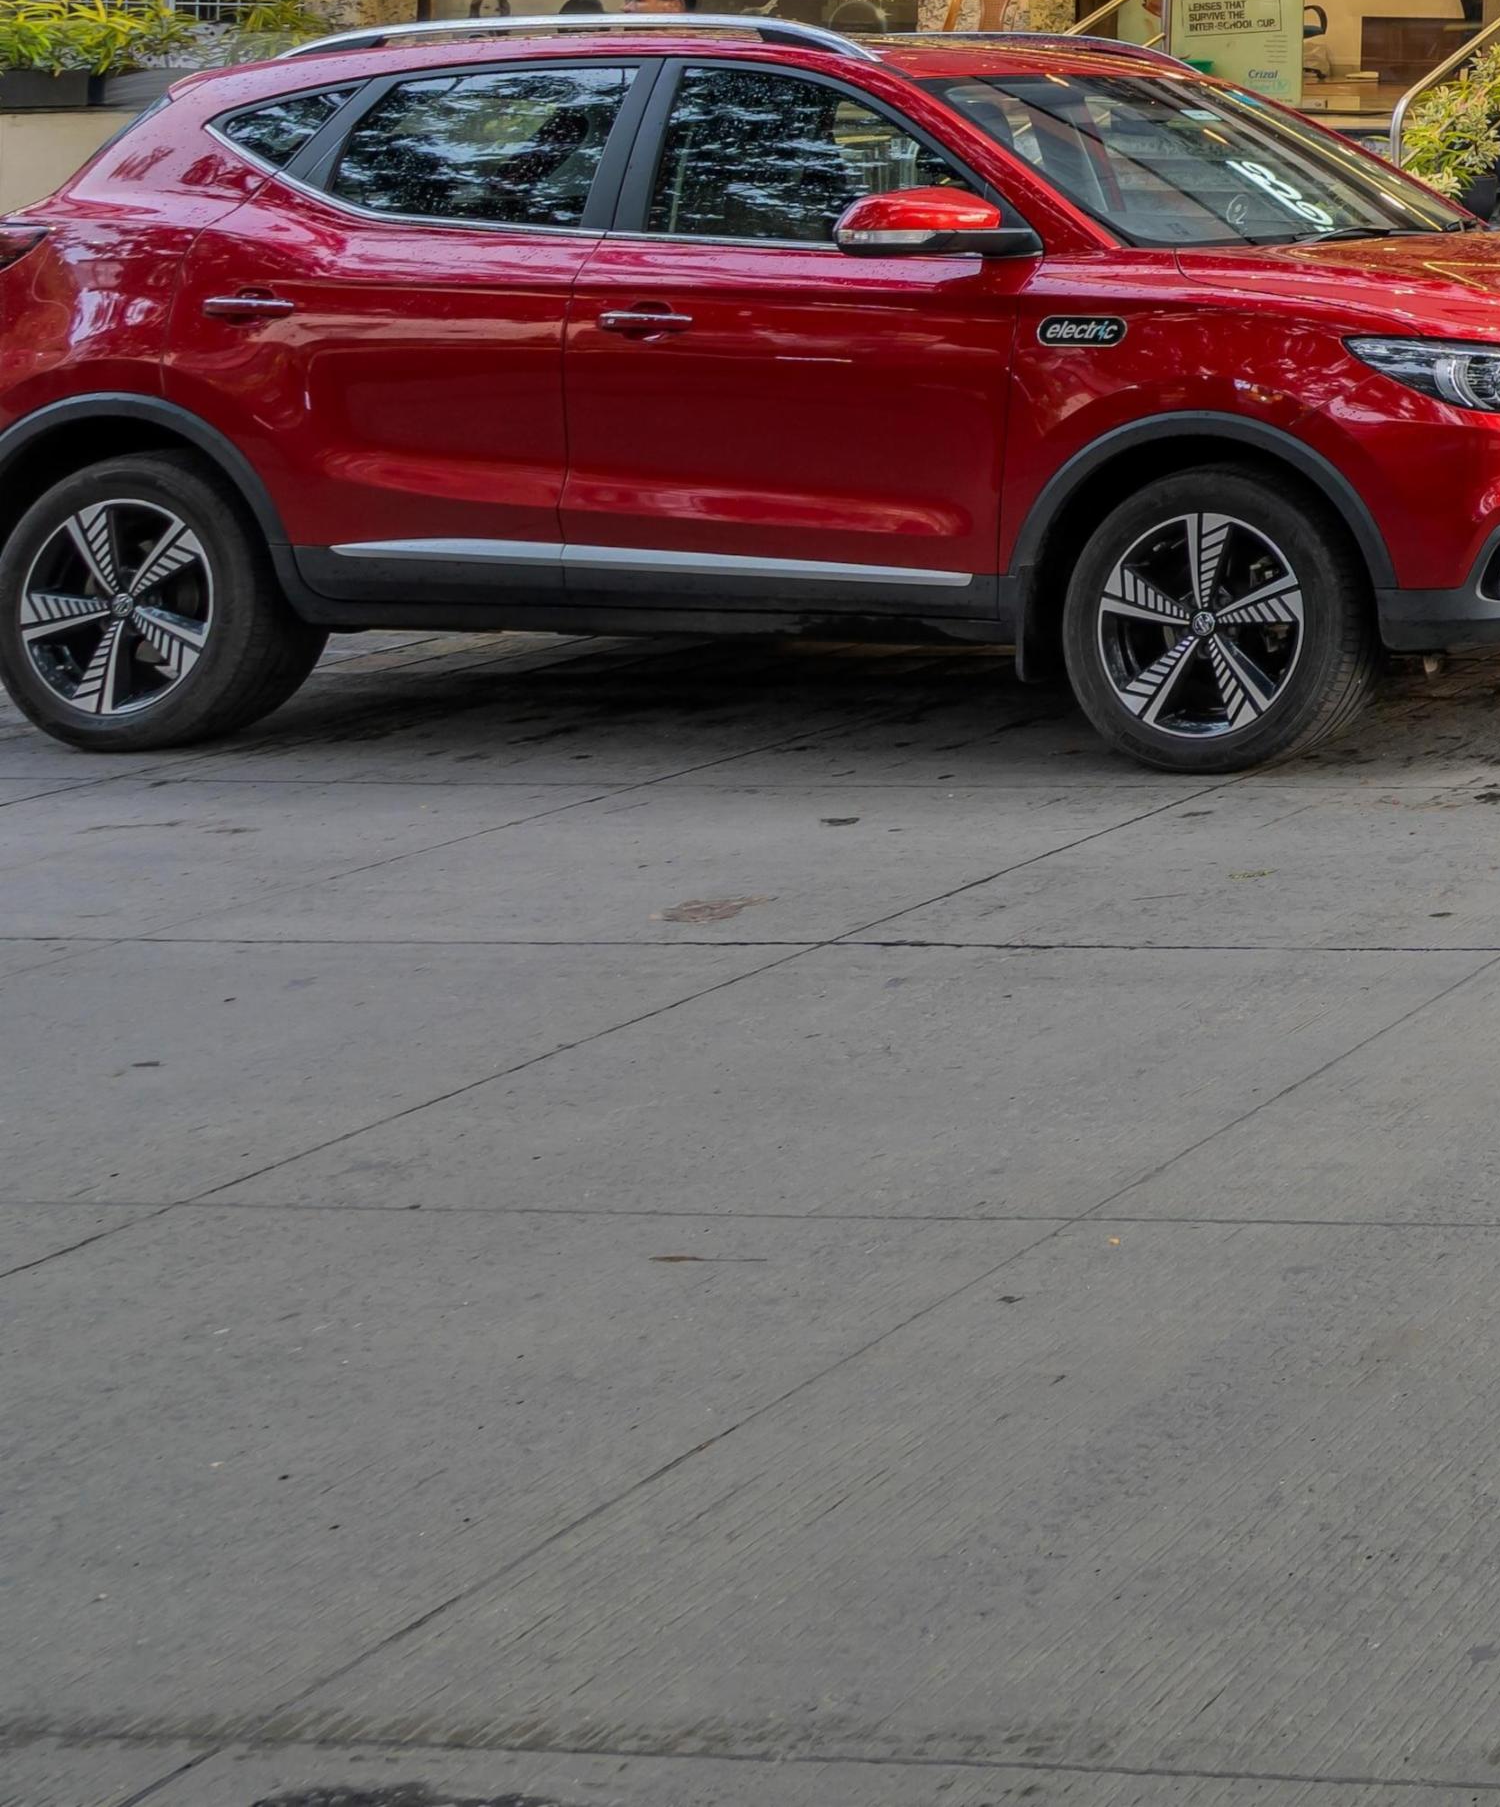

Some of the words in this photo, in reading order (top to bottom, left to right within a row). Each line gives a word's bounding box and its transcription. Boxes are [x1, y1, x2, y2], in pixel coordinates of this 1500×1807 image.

[1189, 2, 1222, 12] LENSES
[1224, 0, 1247, 10] THAT
[1189, 11, 1226, 22] SURVIVE
[1229, 10, 1245, 19] THE
[1248, 69, 1279, 79] Crizal
[1046, 320, 1118, 340] electric
